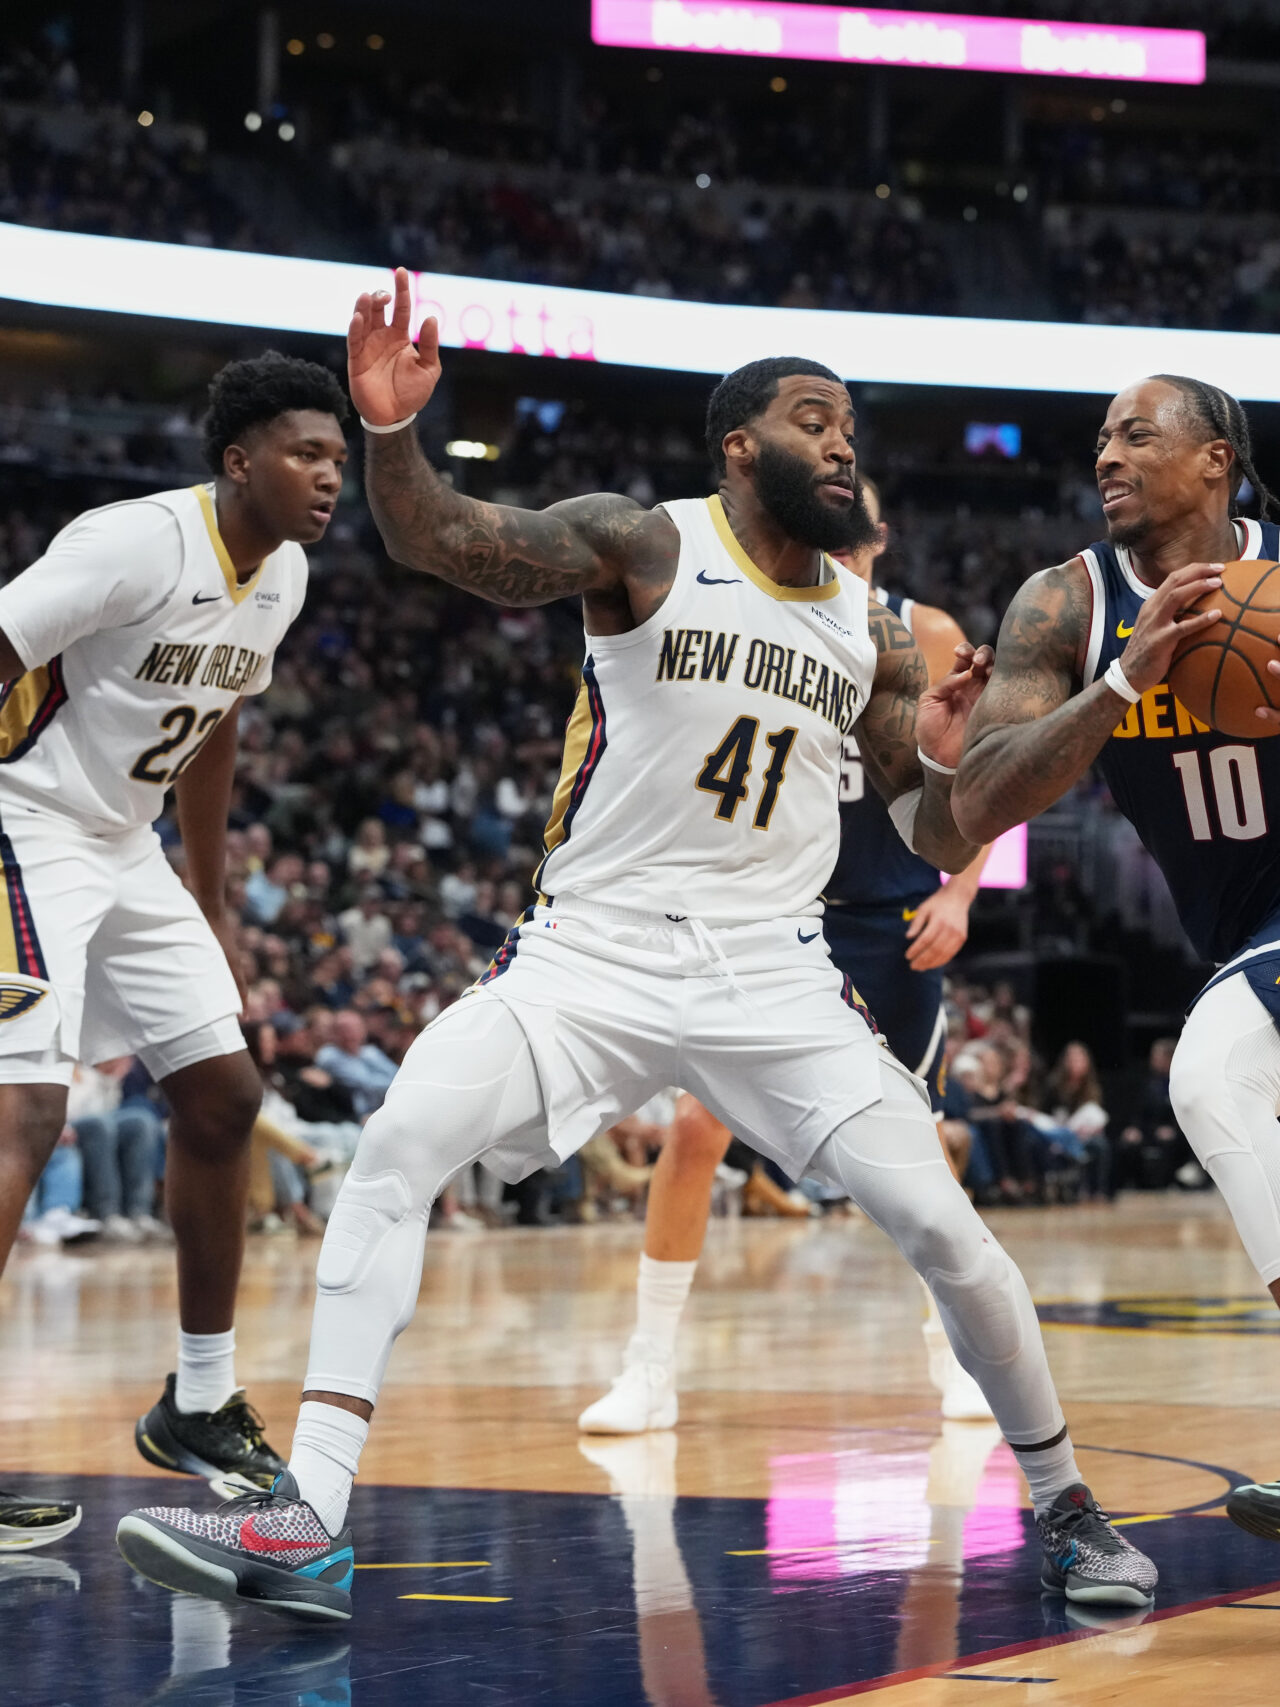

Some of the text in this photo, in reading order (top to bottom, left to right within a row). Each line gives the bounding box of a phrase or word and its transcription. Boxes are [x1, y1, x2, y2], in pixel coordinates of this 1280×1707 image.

[392, 267, 598, 361] botta
[135, 643, 266, 692] NEW ORLEAN
[656, 629, 859, 736] NEW ORLEANS
[694, 714, 799, 832] 41
[1171, 744, 1269, 841] 10
